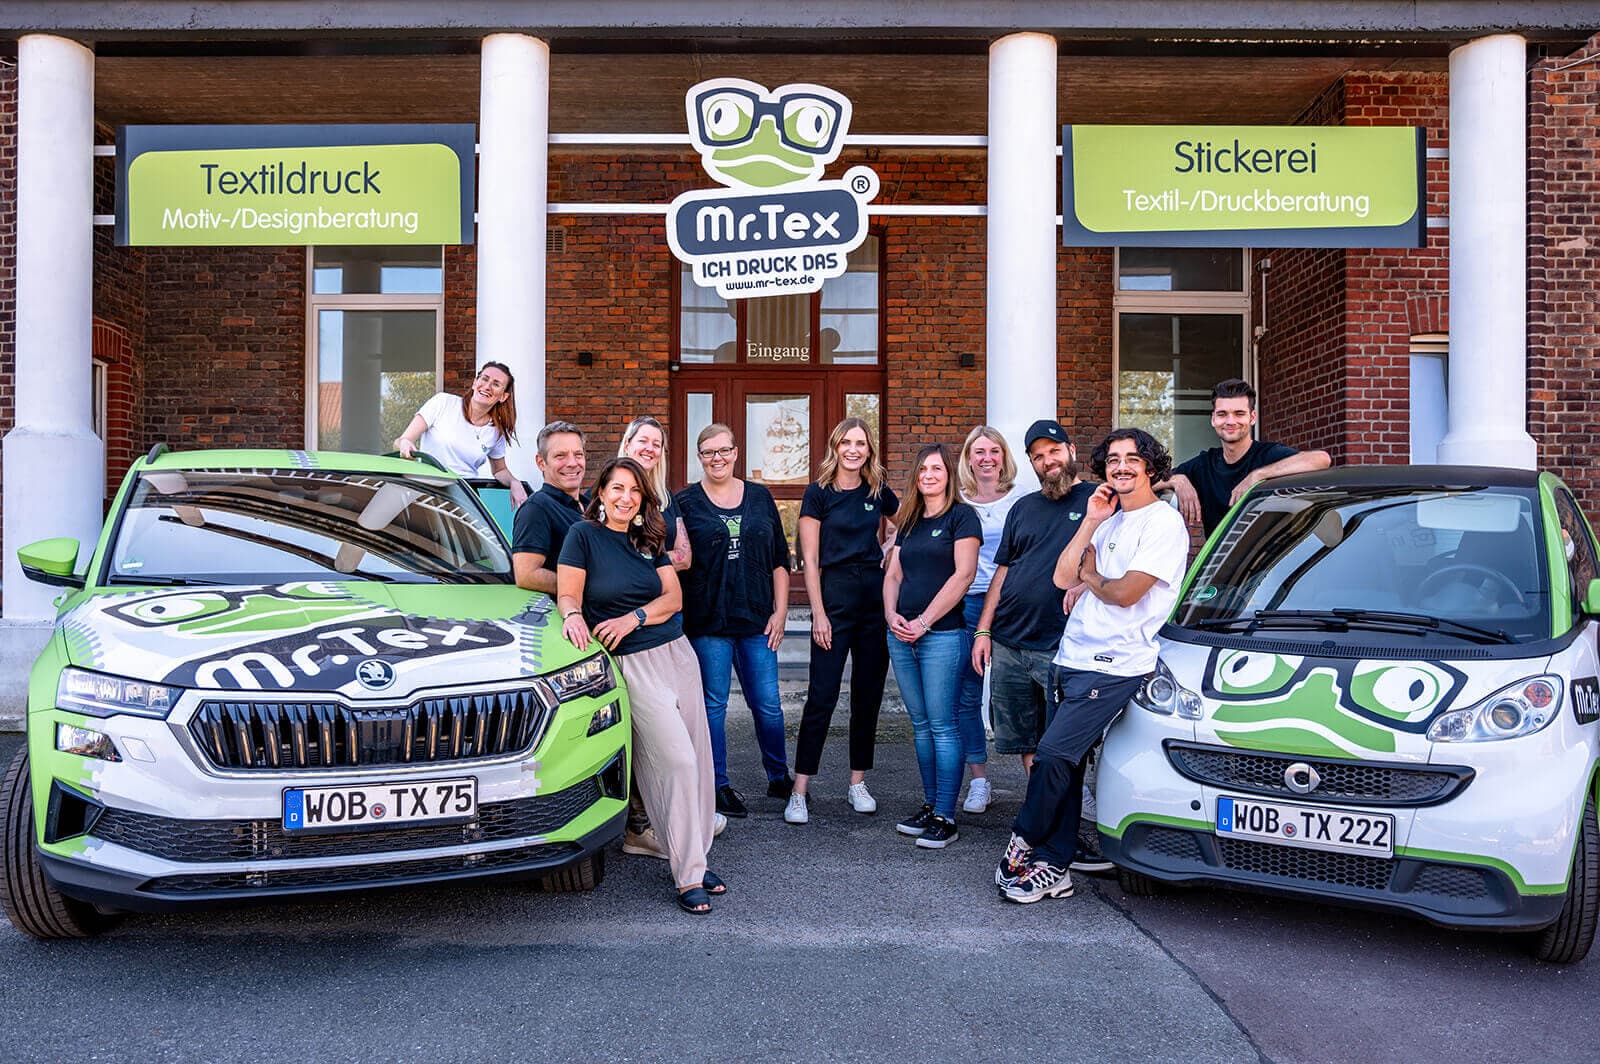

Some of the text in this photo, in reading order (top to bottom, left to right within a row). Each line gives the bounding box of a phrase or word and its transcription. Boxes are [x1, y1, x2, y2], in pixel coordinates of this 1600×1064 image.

[1174, 139, 1317, 173] Stickerei
[200, 161, 381, 195] Textildruck
[1122, 189, 1370, 218] Textil-/Druckberatung
[162, 207, 419, 234] Motiv-/Designberatung
[696, 204, 841, 242] Mr.Tex
[702, 252, 838, 278] ICH DRUCK DAS
[726, 274, 816, 291] www.mr-tex.de
[746, 342, 810, 361] Eingang
[195, 624, 490, 689] Mr.Tex
[290, 813, 298, 822] D
[305, 784, 472, 823] WOB TX 75
[1234, 804, 1388, 847] WOB TX 222
